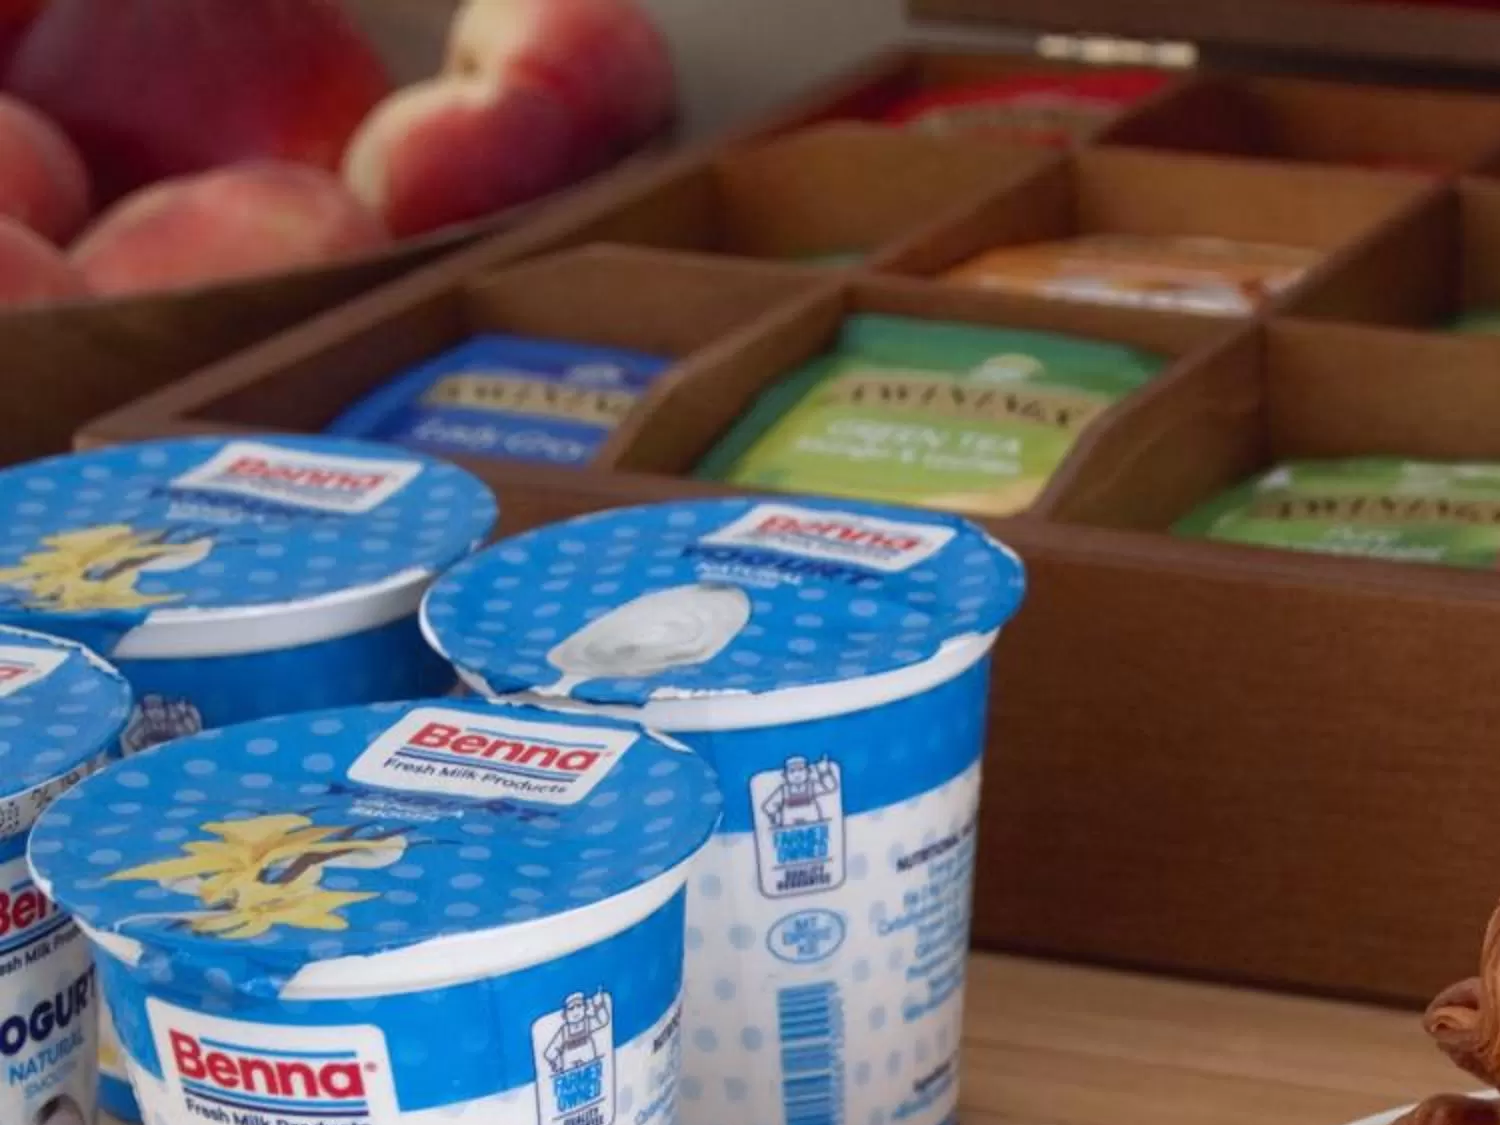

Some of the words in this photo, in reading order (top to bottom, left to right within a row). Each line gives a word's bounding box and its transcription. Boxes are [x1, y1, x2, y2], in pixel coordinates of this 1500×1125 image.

[408, 722, 600, 771] Benna
[383, 757, 436, 777] Fresh
[440, 765, 478, 781] Milk
[482, 772, 568, 794] Products
[168, 1028, 366, 1099] Benna
[186, 1098, 230, 1125] Fresh
